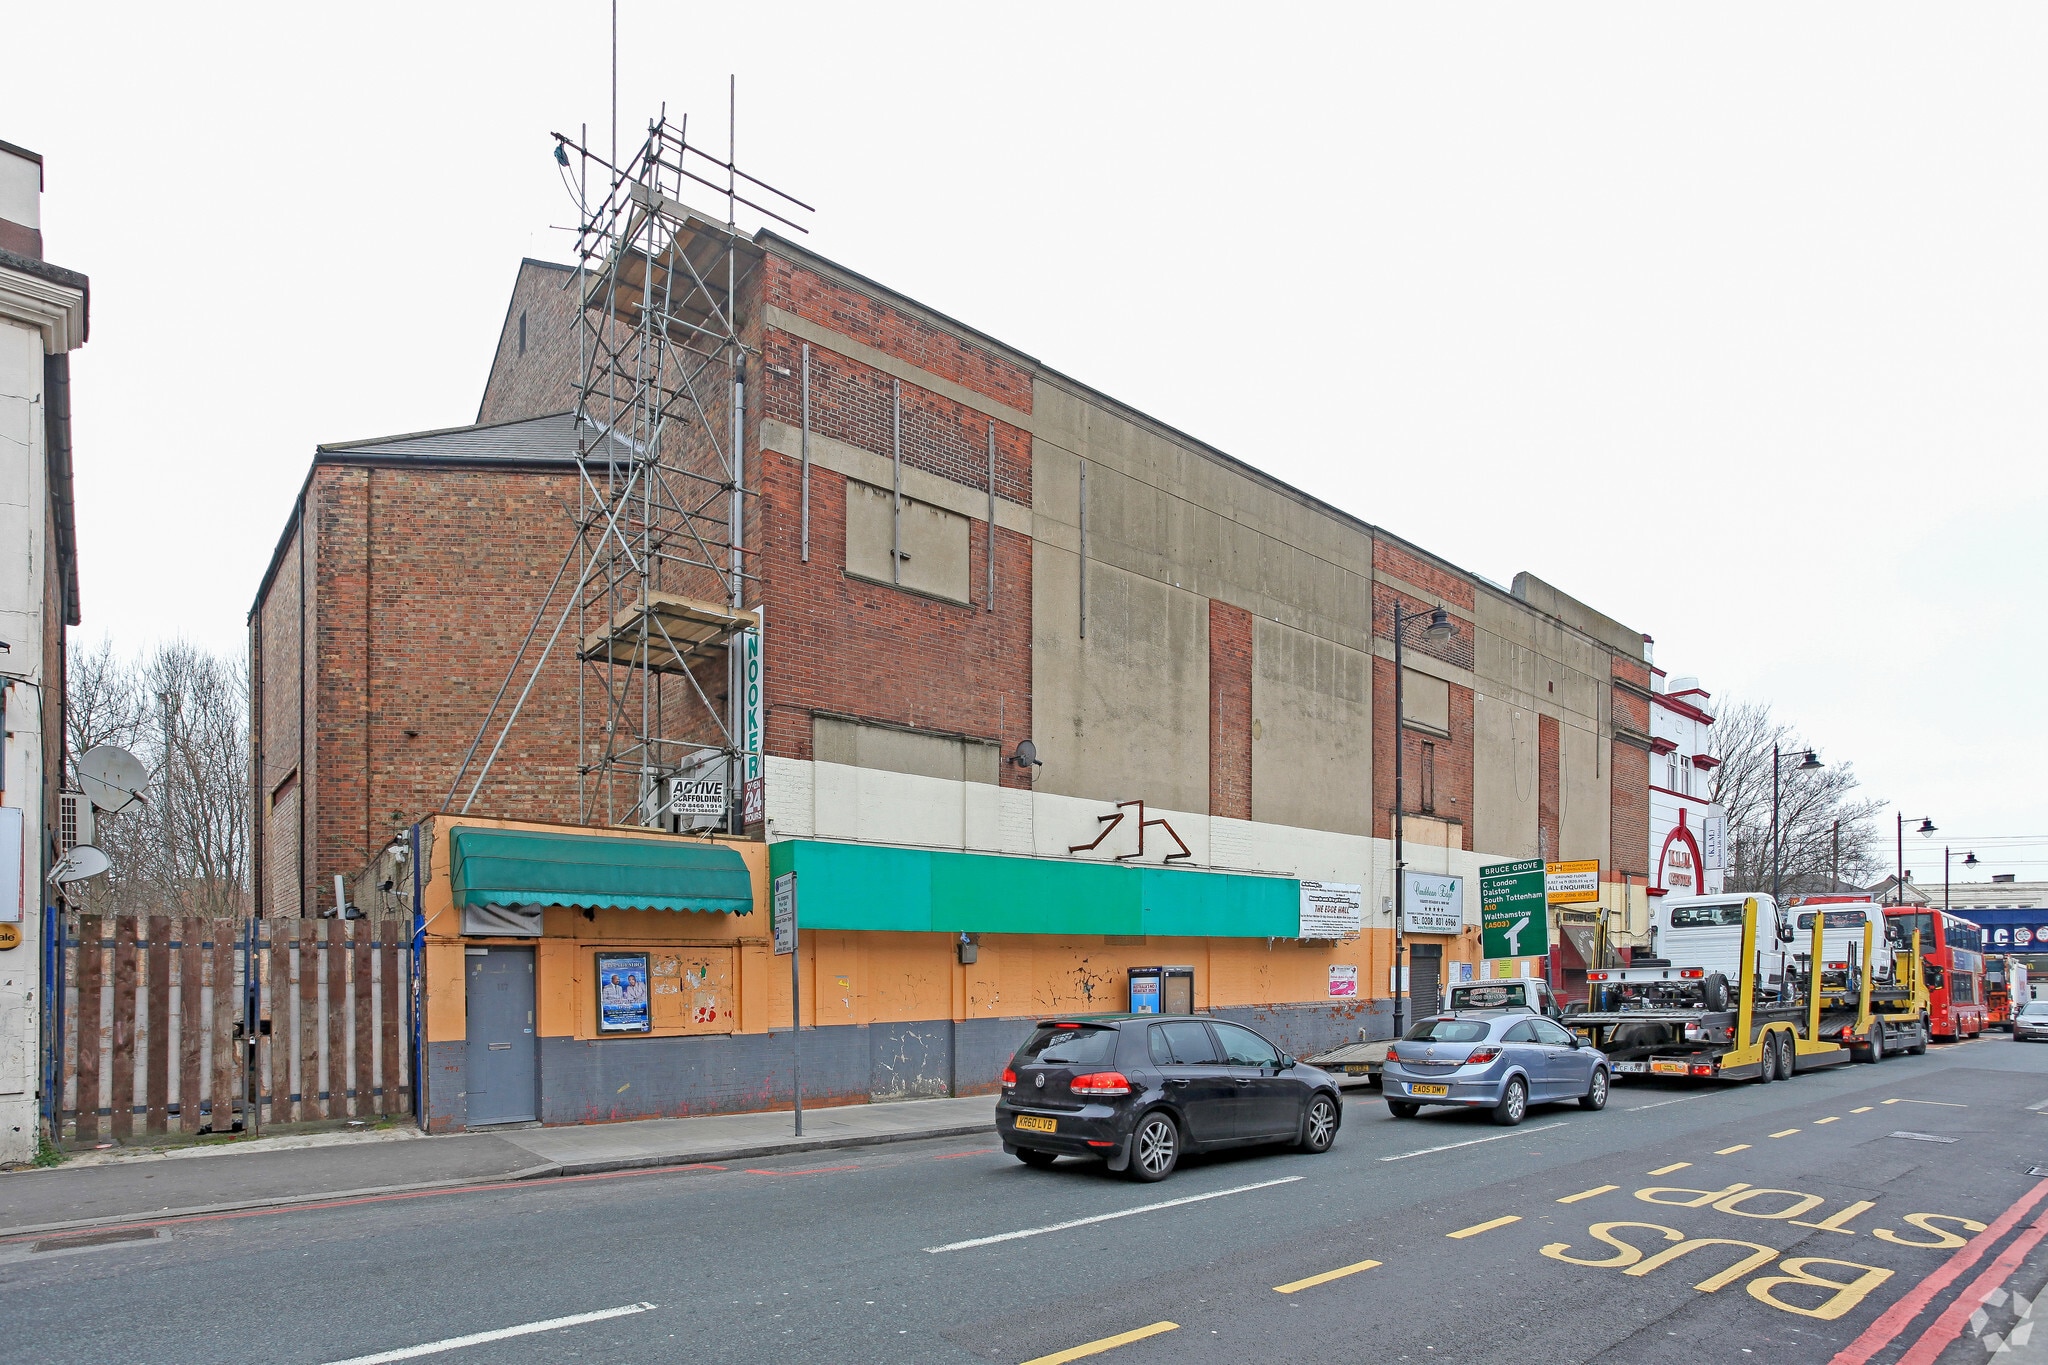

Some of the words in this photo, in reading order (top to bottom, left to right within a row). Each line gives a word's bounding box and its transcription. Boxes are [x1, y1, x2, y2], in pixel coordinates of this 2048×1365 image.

[748, 626, 758, 780] NOOKER
[672, 781, 722, 794] ACTIVE
[673, 794, 722, 803] SCAFFOLDING
[745, 789, 762, 814] 24
[745, 811, 762, 823] HOURS
[1485, 866, 1510, 875] BRUCE
[1512, 862, 1537, 871] GROVE
[1483, 888, 1510, 896] Dalston
[1506, 892, 1542, 901] Tottenham
[1412, 916, 1420, 924] TEL:
[1422, 916, 1433, 925] 0208
[1484, 910, 1531, 920] Walthamstow
[1485, 920, 1510, 929] (A503)
[1412, 1085, 1430, 1093] EA05
[1432, 1085, 1446, 1094] DMY
[1018, 1117, 1037, 1127] KR60
[1037, 1118, 1053, 1130] LVB
[1634, 1182, 1988, 1248] STOP
[1539, 1221, 1894, 1320] BUS
